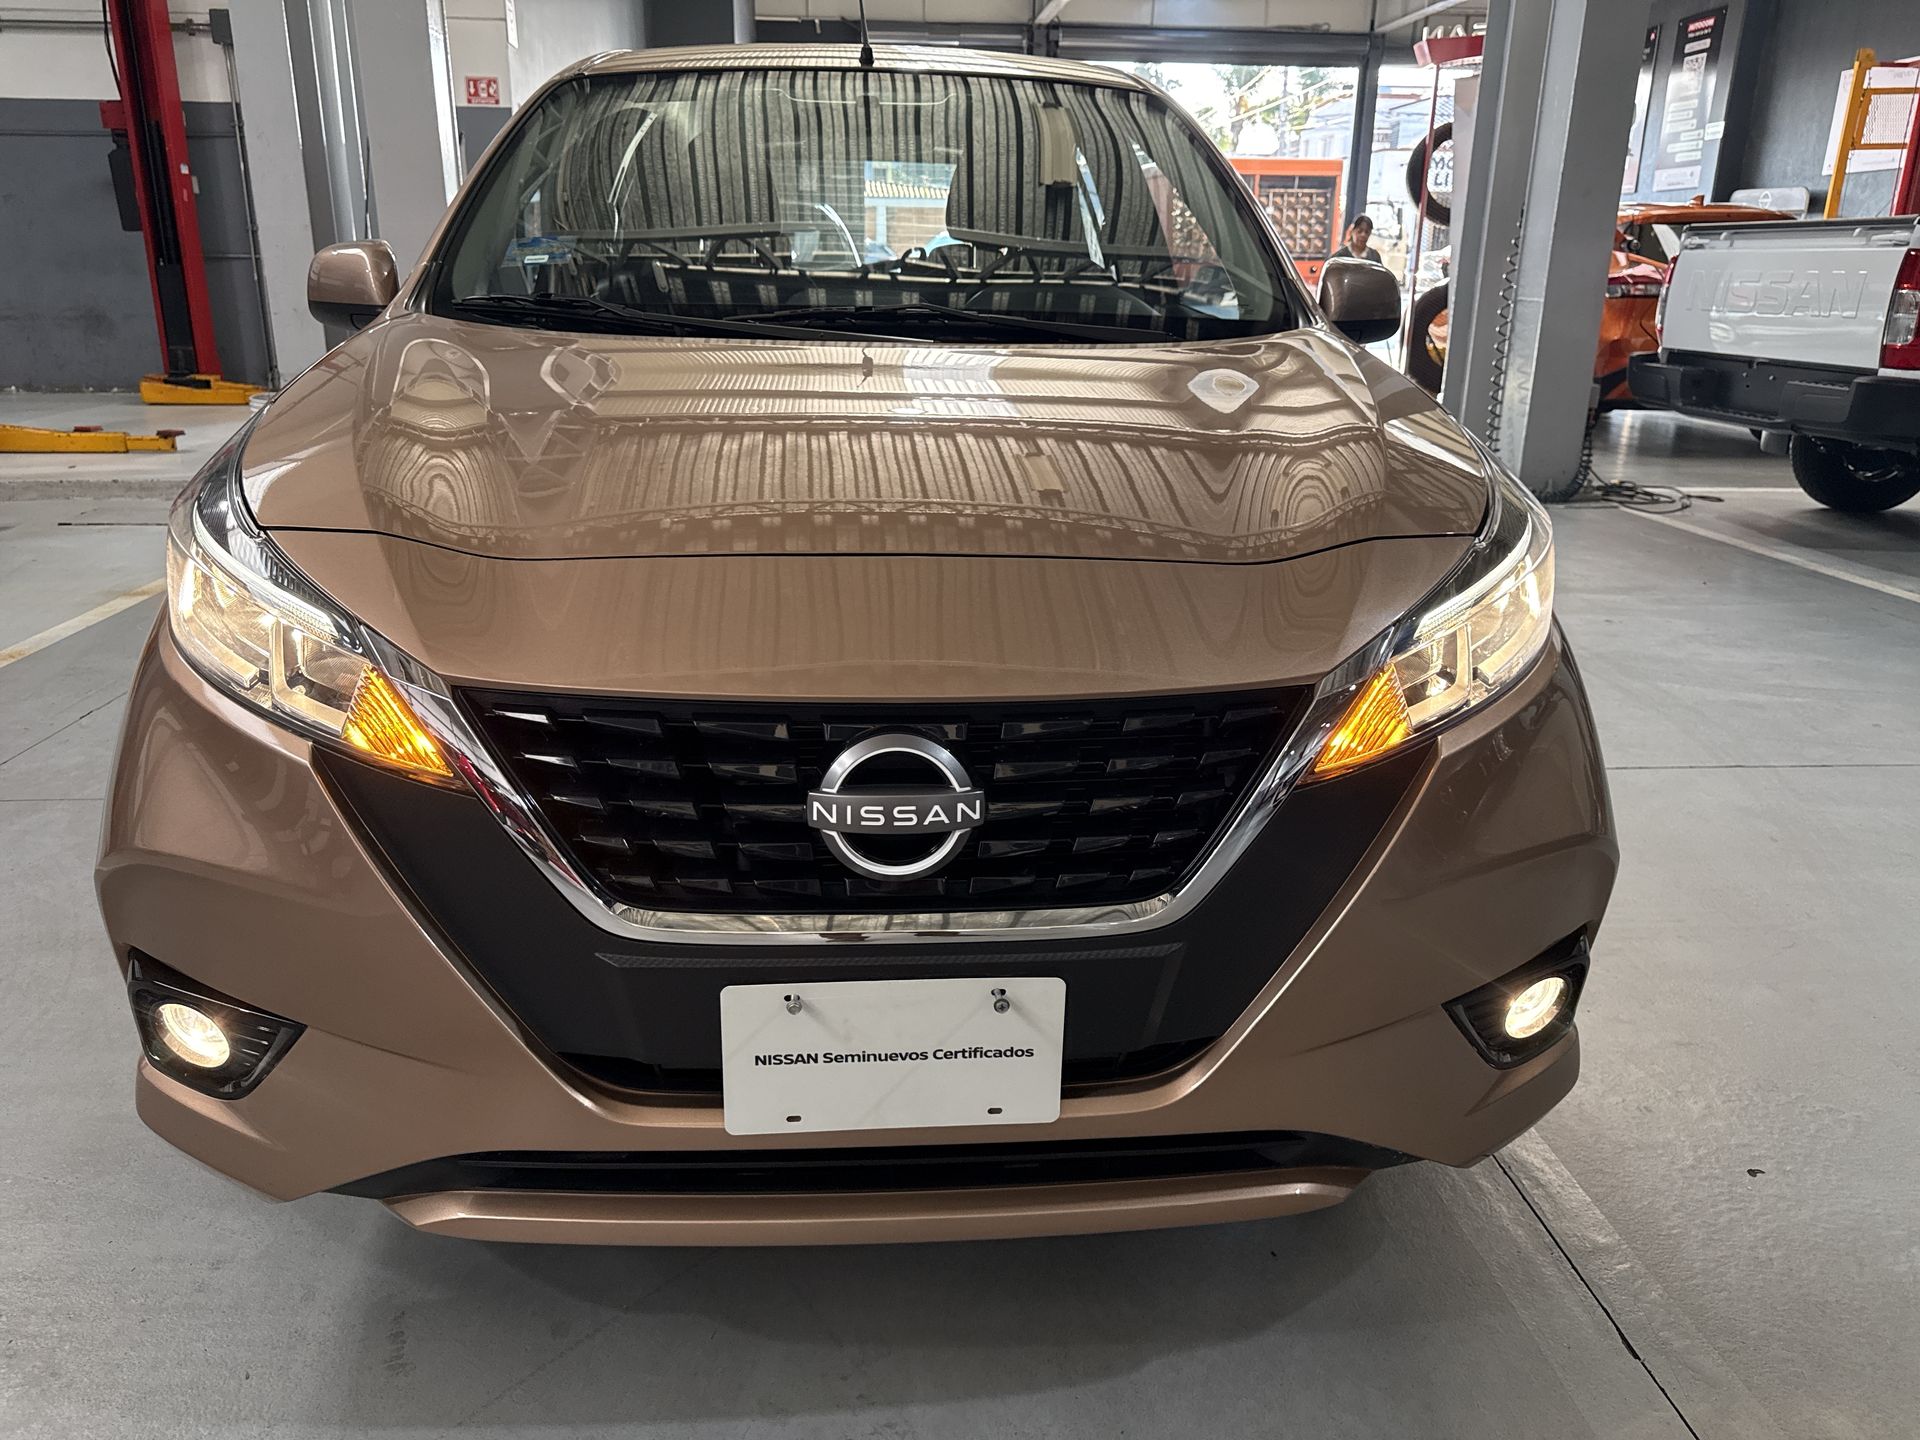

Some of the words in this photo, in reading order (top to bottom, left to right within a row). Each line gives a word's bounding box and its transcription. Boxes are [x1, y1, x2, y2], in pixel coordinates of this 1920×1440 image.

[1686, 269, 1868, 320] NISSAN
[812, 800, 981, 826] NISSAN
[754, 1053, 819, 1066] NISSAN
[822, 1050, 929, 1064] Seminuevos
[932, 1046, 1035, 1060] Certificados
